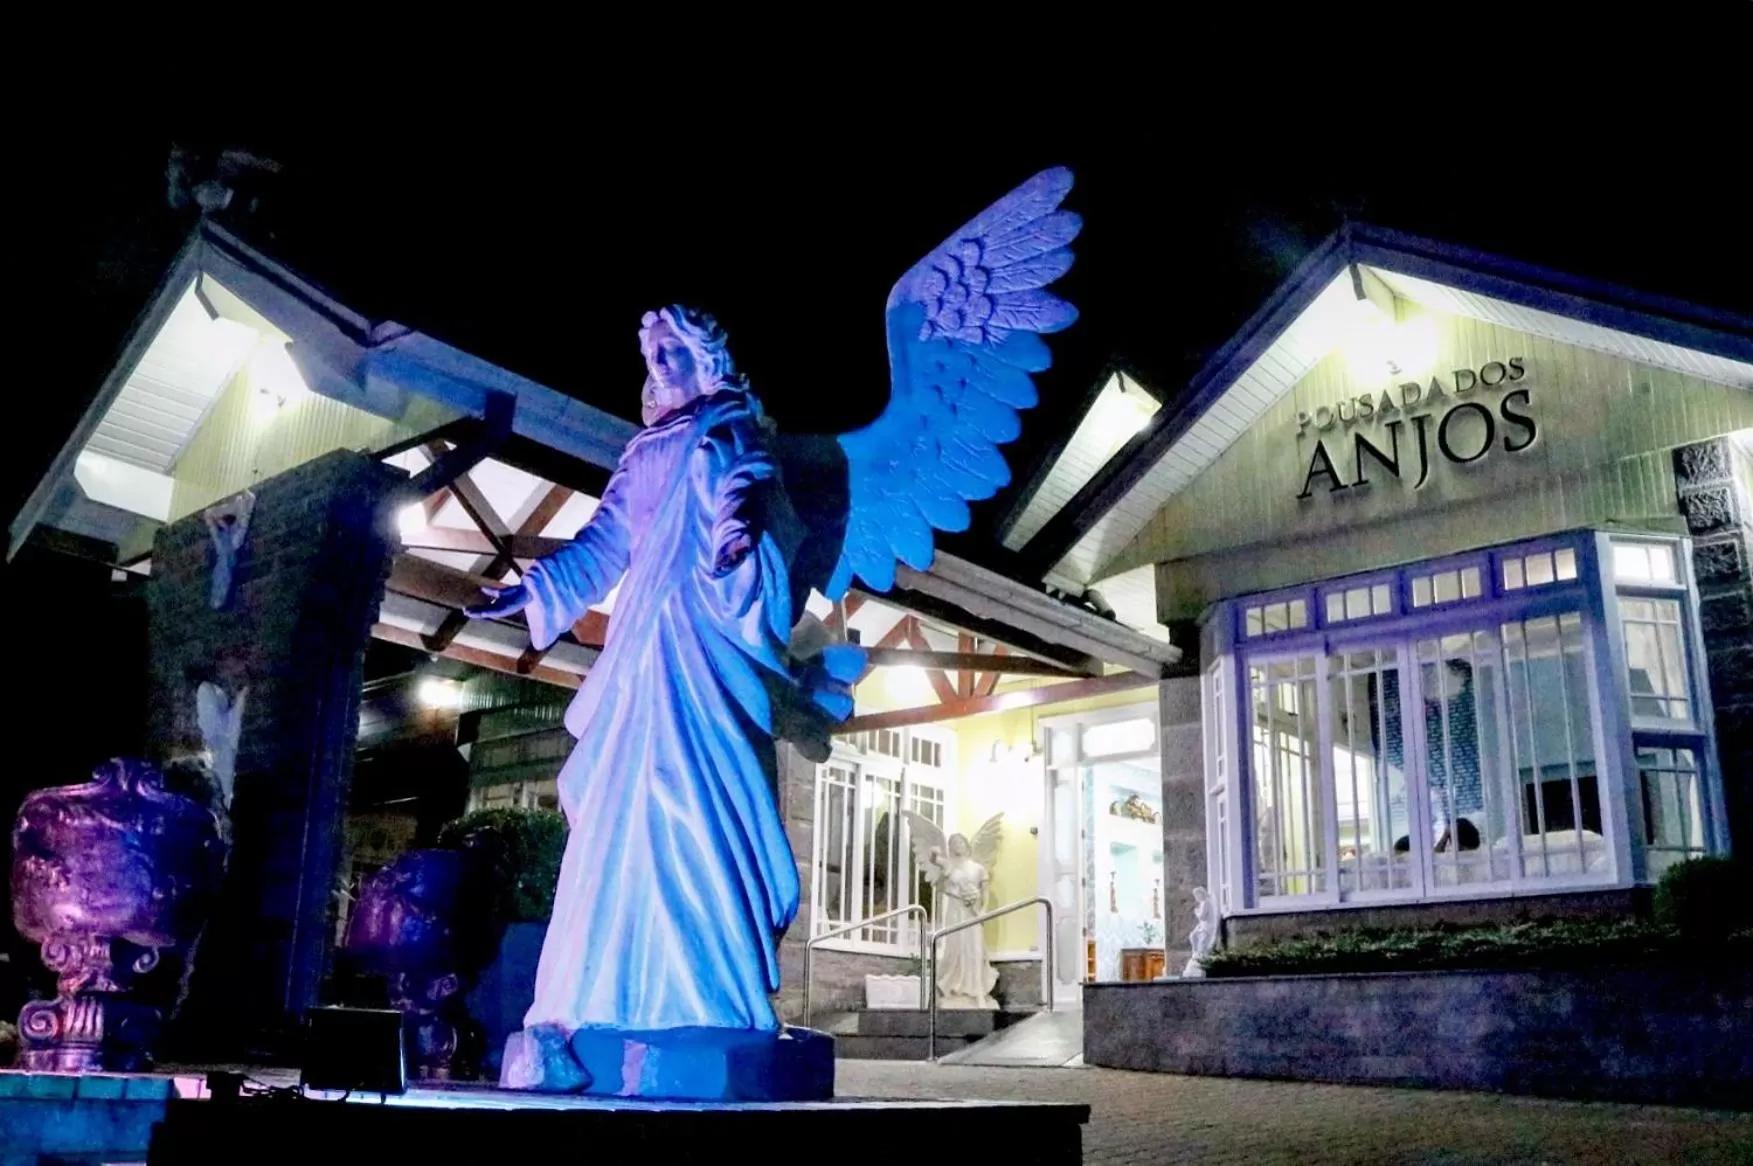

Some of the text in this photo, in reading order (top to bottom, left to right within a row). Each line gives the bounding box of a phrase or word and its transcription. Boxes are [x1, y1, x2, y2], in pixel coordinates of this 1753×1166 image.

[1296, 357, 1525, 434] POUSADA DOS
[1296, 389, 1538, 499] ANJOS
